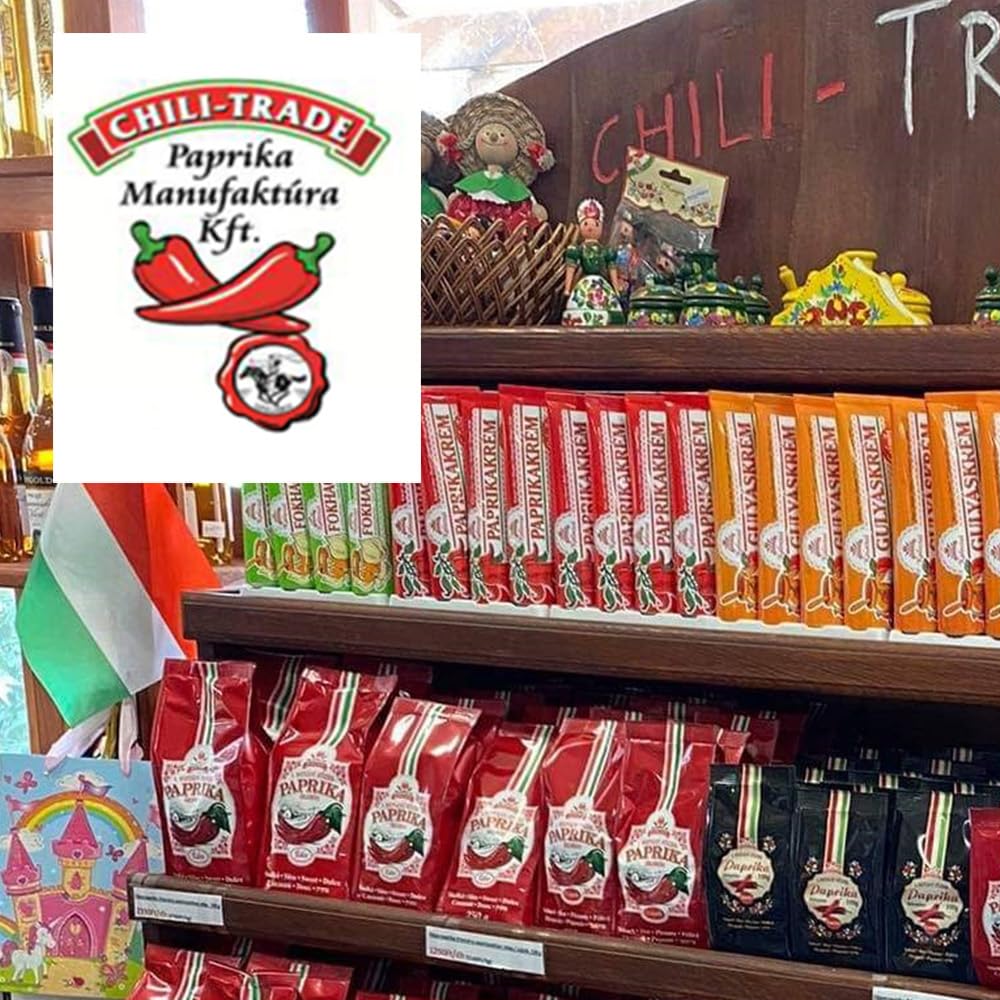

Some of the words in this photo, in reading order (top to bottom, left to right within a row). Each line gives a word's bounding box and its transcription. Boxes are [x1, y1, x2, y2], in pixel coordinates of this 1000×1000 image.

[592, 52, 775, 186] CHILI
[279, 778, 346, 804] PAPRIKA
[371, 807, 427, 831] PAPRIKA
[548, 827, 606, 851] PAPRIKA
[626, 844, 689, 869] PAPRIKA
